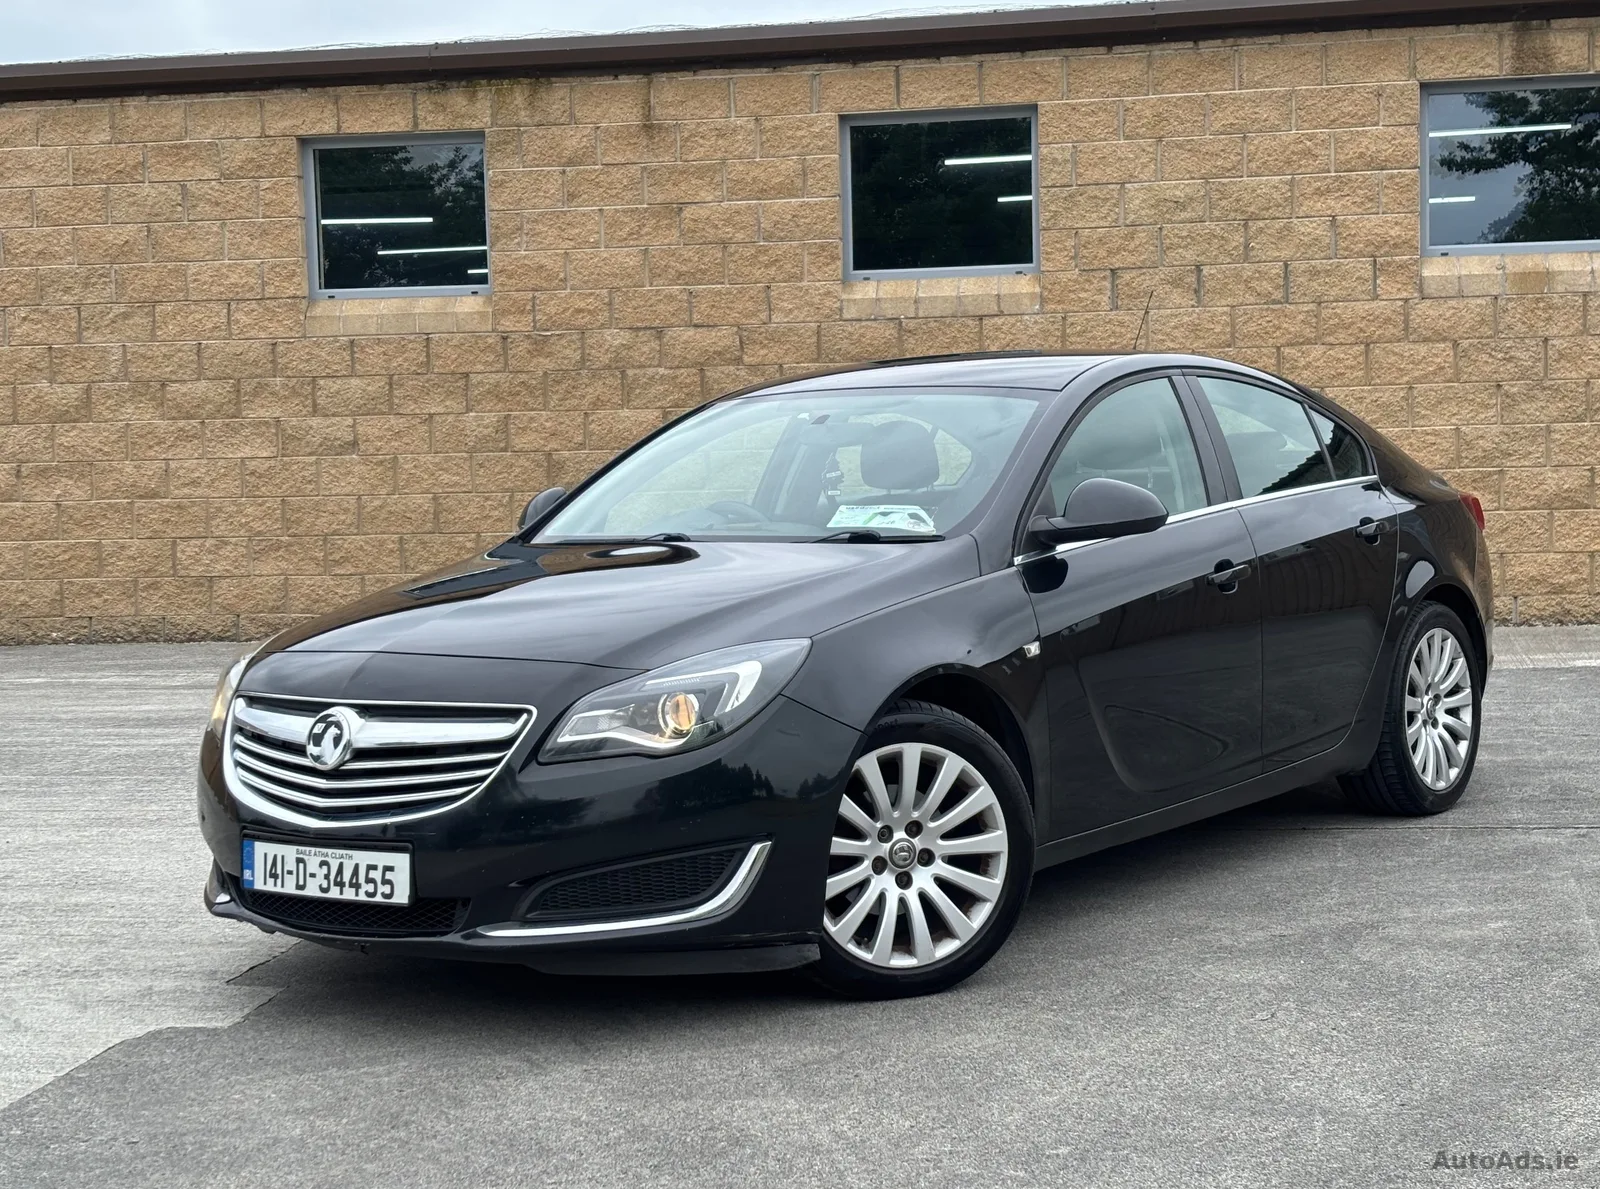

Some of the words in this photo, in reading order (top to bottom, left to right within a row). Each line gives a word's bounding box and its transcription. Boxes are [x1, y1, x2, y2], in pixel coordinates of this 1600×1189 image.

[295, 848, 312, 856] BAILE
[330, 852, 353, 860] CLIATH
[263, 853, 395, 900] 141-D-34455
